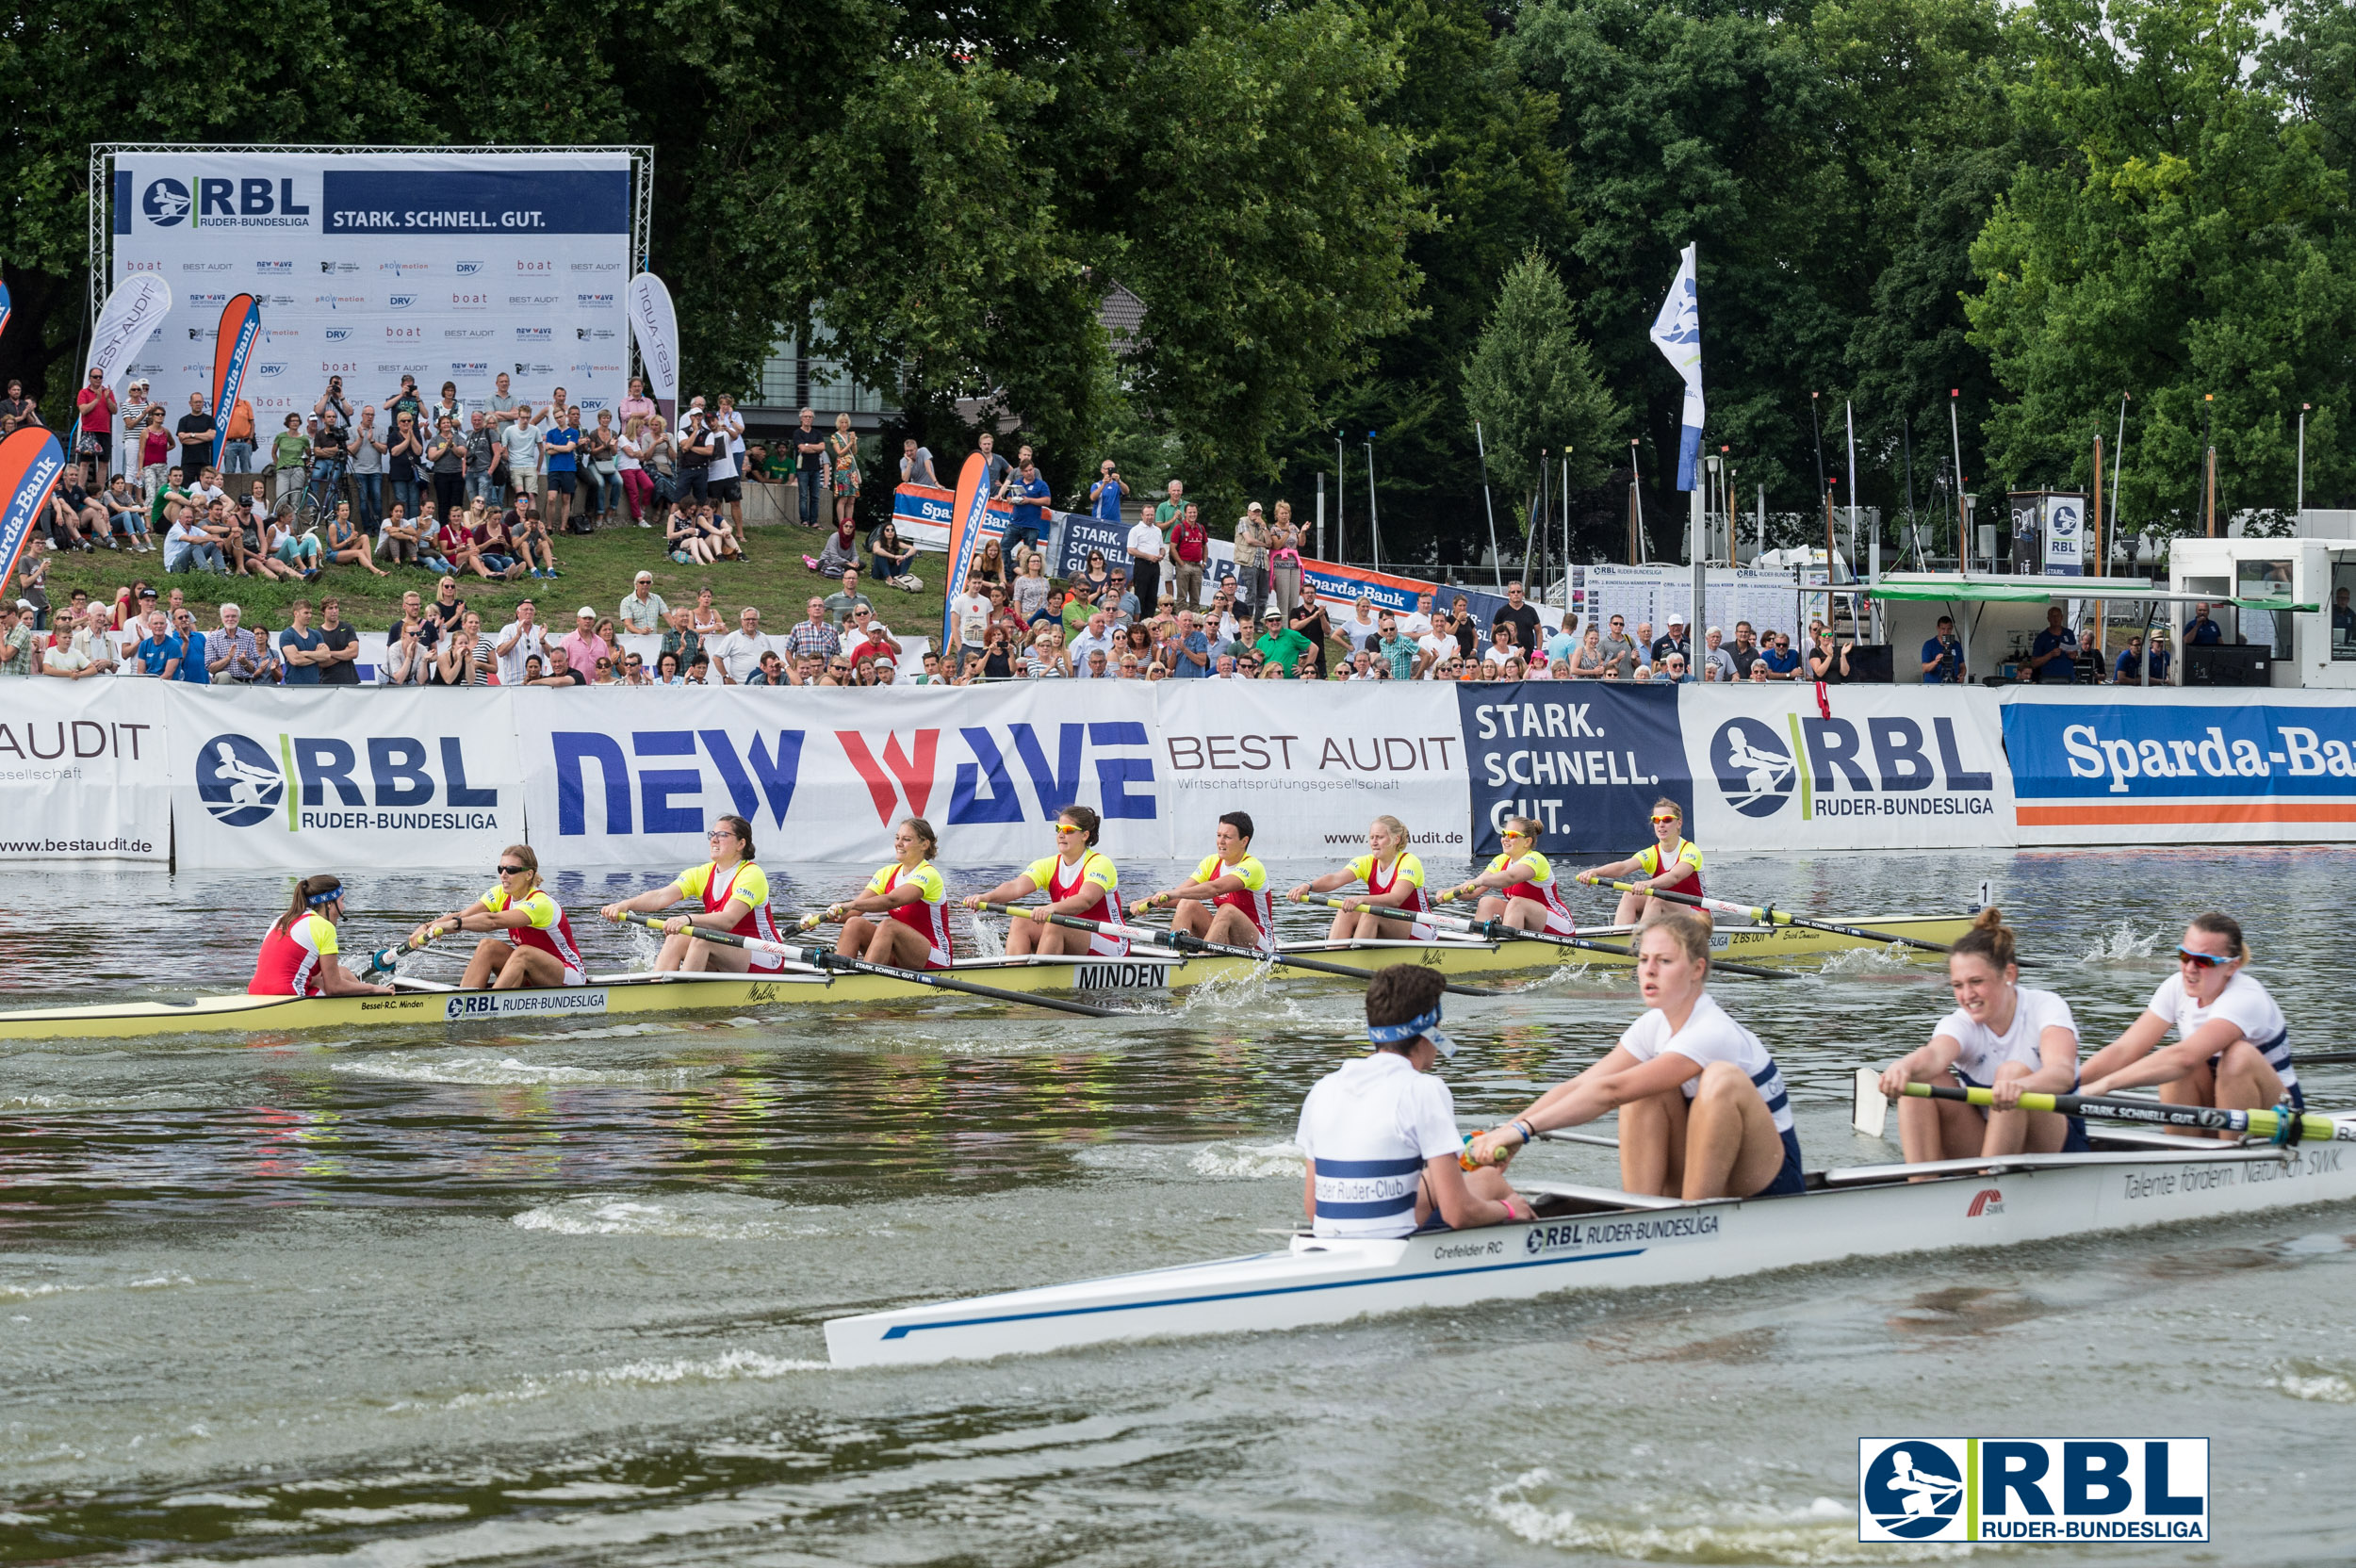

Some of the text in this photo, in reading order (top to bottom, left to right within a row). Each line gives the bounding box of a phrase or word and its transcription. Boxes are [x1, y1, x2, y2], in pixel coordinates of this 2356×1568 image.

[201, 178, 309, 215] RBL
[201, 218, 309, 227] RUDER-BUNDESLIGA
[333, 211, 546, 227] STARK. SCHNELL. GUT.
[127, 260, 162, 270] boat
[517, 260, 551, 270] boat
[452, 293, 487, 303] boat
[98, 335, 122, 369] EST
[123, 283, 155, 335] AUDIT
[386, 327, 421, 336] boat
[216, 318, 256, 432] Sparda-Bank
[322, 361, 357, 371] boat
[257, 396, 291, 406] boat
[0, 456, 57, 567] arda-Bank
[949, 482, 989, 606] Sparda-Bank
[1072, 525, 1121, 546] STARK.
[2052, 541, 2076, 552] RBL
[1067, 558, 1088, 572] GU
[1304, 573, 1405, 606] Sparda-Bank
[1475, 703, 1604, 739] STARK.
[0, 721, 150, 760] AUDIT
[1167, 735, 1456, 771] BEST AUDIT
[1801, 717, 1993, 792] RBL
[2063, 724, 2356, 792] Sparda-Ba
[294, 737, 498, 807] RBL
[1484, 750, 1659, 787] SCHNELL.
[551, 721, 1157, 836] NEW WAVE
[1177, 778, 1400, 792] Wirtschaftsprüfungsgesellschaft
[1815, 798, 1994, 816] RUDER-BUNDESLIGA
[303, 812, 498, 829] RUDER-BUNDESLIGA
[1982, 882, 1987, 903] 1
[1811, 922, 1834, 931] SCHNELL.
[1519, 930, 1536, 938] STARK.
[1537, 934, 1561, 942] SCHNELL.
[1733, 933, 1739, 944] Z
[1740, 933, 1749, 943] BS
[1207, 943, 1225, 952] STARK.
[1226, 947, 1251, 956] SCHNELL.
[1419, 948, 1442, 966] Melitta
[855, 962, 874, 972] STARK.
[875, 966, 901, 977] SCHNELL.
[901, 972, 914, 980] GUT.
[1079, 964, 1165, 989] MINDEN
[744, 982, 777, 1002] Melitta
[361, 1002, 398, 1011] Bessel-R.C.
[465, 995, 605, 1013] RBL RUDER-BUNDESLIGA
[1371, 1025, 1414, 1041] NK NK
[2079, 1103, 2197, 1126] STARK. SCHNELL. GUT.
[2124, 1148, 2344, 1200] Talente fördern. SWK.
[1338, 1180, 1404, 1200] Ruder-Club
[1985, 1202, 2005, 1216] SWK
[1546, 1216, 1719, 1246] RBL RUDER-BUNDESLIGA
[1434, 1241, 1503, 1260] Crefelder RC
